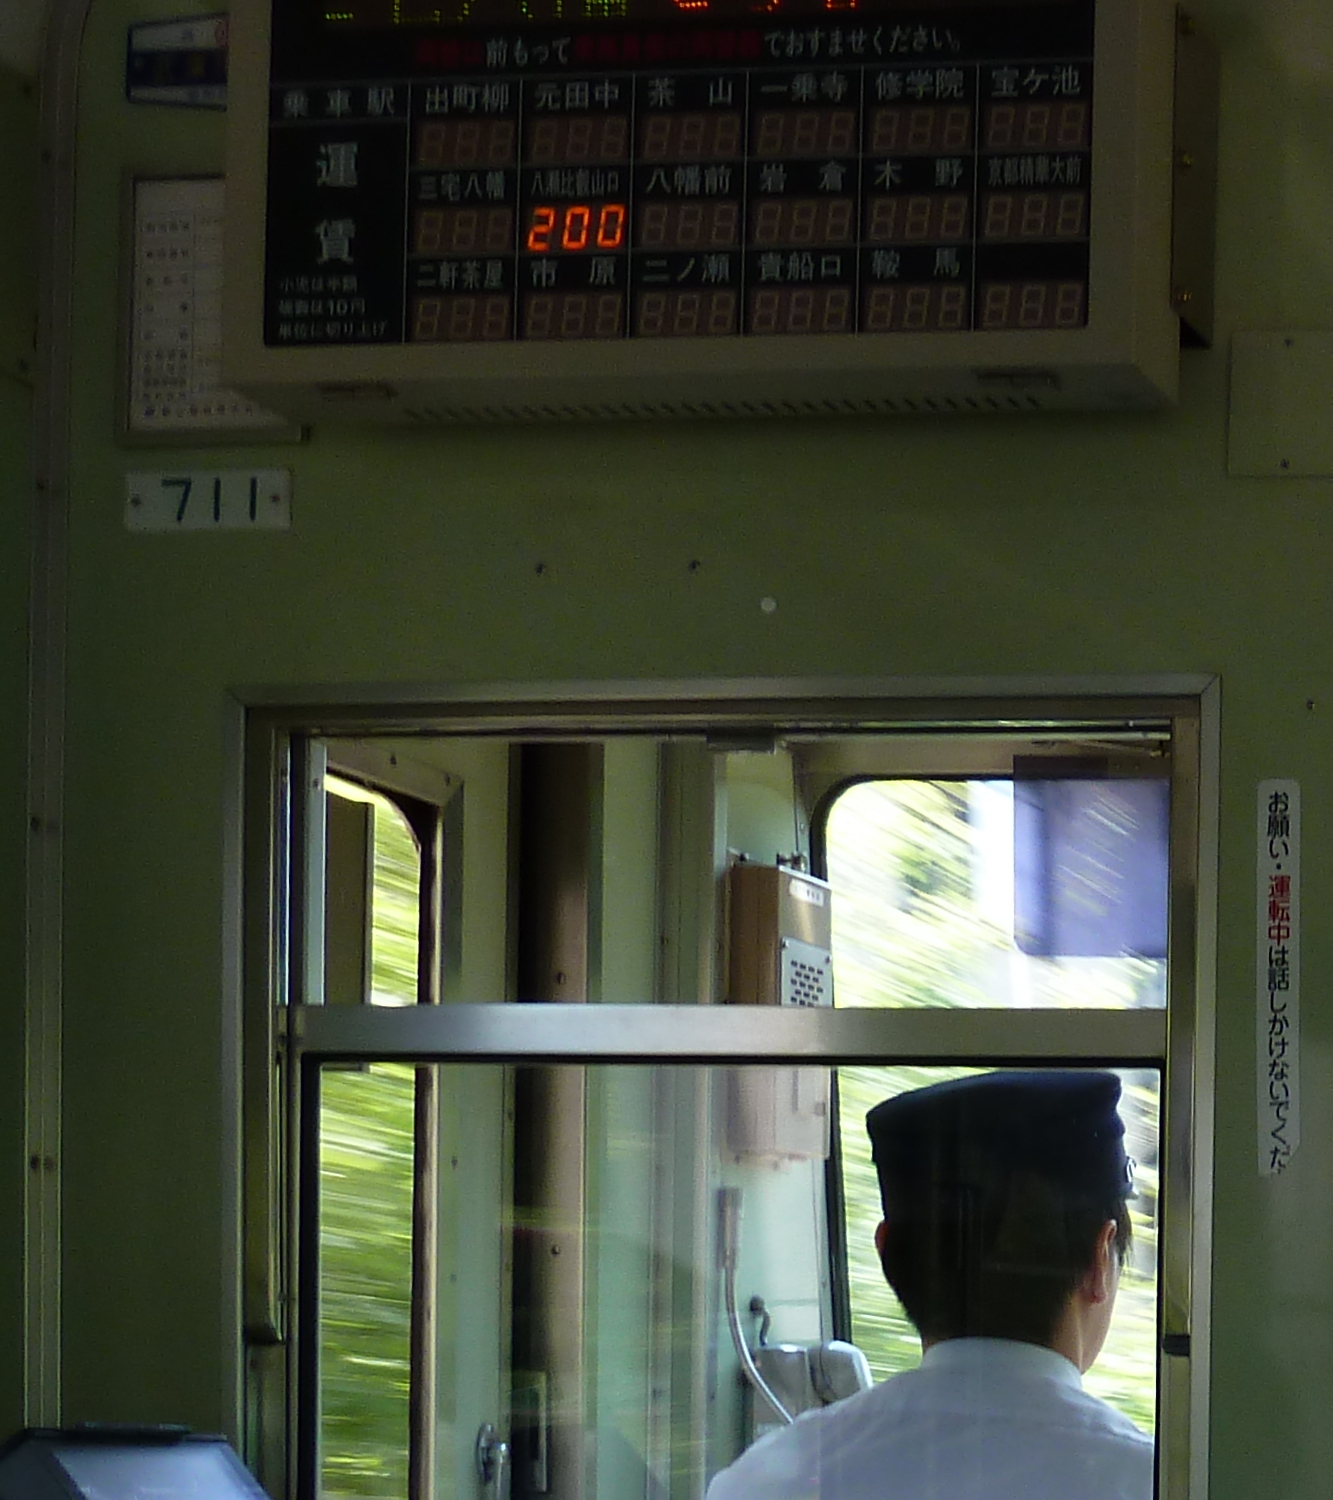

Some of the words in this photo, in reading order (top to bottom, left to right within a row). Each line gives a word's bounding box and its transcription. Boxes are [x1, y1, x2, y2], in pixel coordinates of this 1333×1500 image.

[485, 36, 572, 68] 前もって
[535, 81, 619, 110] 元田中
[648, 78, 733, 107] 茶山
[761, 71, 848, 102] 一乗寺
[876, 68, 965, 99] 修学院
[283, 86, 395, 117] 乗車駅
[425, 85, 510, 116] 出町柳
[419, 171, 505, 201] 三宅八幡
[646, 164, 731, 196] 八幡前
[760, 161, 847, 193] 岩倉
[875, 158, 962, 189] 木野
[316, 141, 360, 266] 運賃
[526, 202, 626, 252] 200
[417, 259, 503, 290] 二軒茶屋
[530, 256, 616, 288] 市原
[643, 252, 730, 283] 二ノ瀬
[757, 251, 842, 283] 貴船口
[871, 247, 961, 278] 鞍馬
[162, 477, 257, 522] 711
[1267, 791, 1291, 1174] お願い・運転中は話しかけないでくだ
